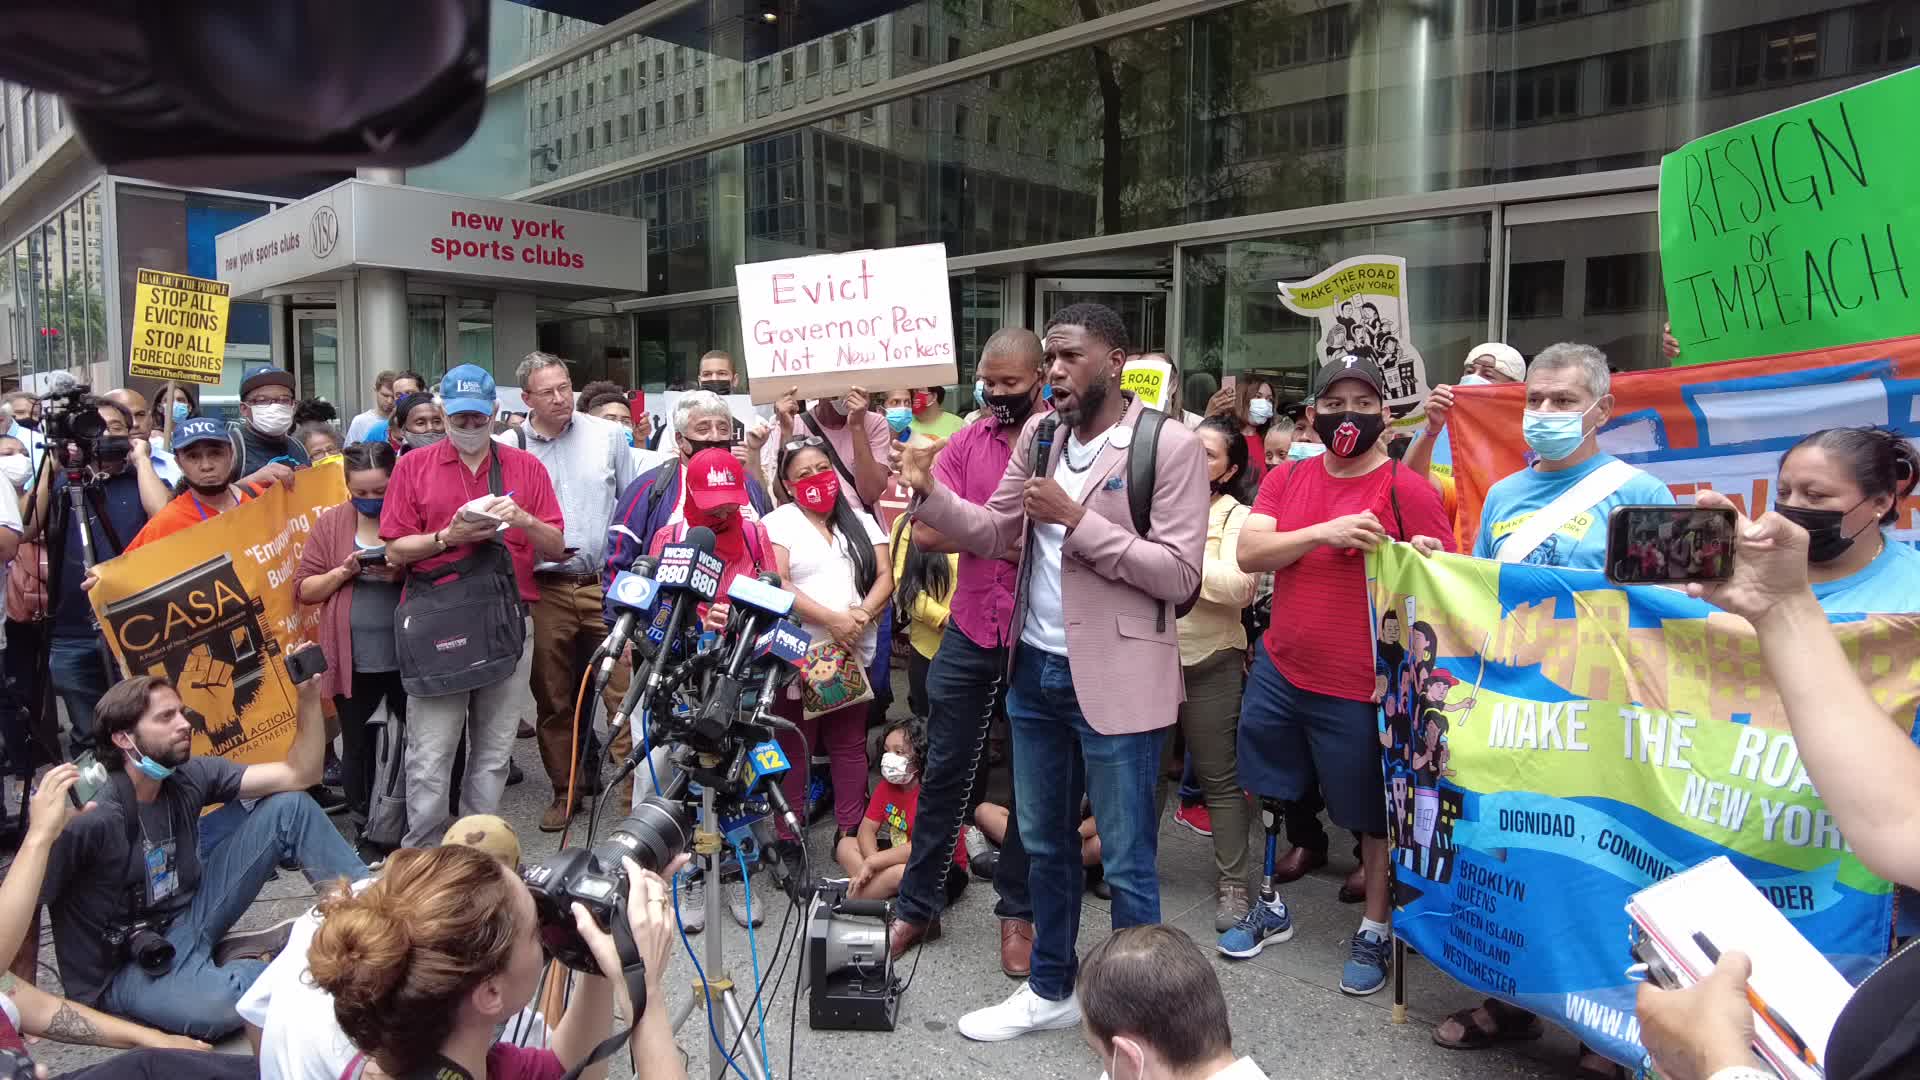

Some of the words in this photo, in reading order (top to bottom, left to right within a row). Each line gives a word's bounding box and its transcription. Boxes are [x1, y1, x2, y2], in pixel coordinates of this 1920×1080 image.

[1685, 102, 1868, 241] RESIGN
[312, 211, 334, 254] NYSC
[451, 210, 504, 232] new
[512, 219, 565, 241] york
[225, 258, 238, 272] new
[239, 251, 254, 272] york
[256, 239, 279, 265] sports
[279, 231, 300, 255] clubs
[431, 236, 514, 262] sports
[522, 243, 585, 269] clubs
[1750, 224, 1782, 263] or
[141, 271, 160, 285] BAIL
[162, 274, 180, 287] OUT
[182, 277, 196, 291] THE
[197, 279, 228, 295] PEOPLE
[772, 258, 875, 305] Evict
[1301, 284, 1333, 302] MAKE
[1332, 270, 1356, 289] THE
[1358, 268, 1396, 280] ROAD
[1343, 281, 1365, 295] NEW
[1368, 280, 1396, 292] YORK
[1673, 223, 1909, 346] IMPEACH
[151, 288, 189, 308] STOP
[190, 293, 215, 312] ALL
[145, 306, 218, 331] EVICTIONS
[754, 315, 882, 346] Governor
[891, 305, 937, 336] Perv
[145, 329, 184, 350] STOP
[186, 335, 213, 354] ALL
[772, 347, 815, 373] Not
[879, 337, 951, 363] Yorkers
[133, 348, 221, 371] FORECLOSURES
[1128, 374, 1160, 386] ROAD
[183, 422, 216, 437] NYC
[664, 547, 695, 559] WCBS
[698, 551, 723, 574] WCBS
[656, 564, 690, 584] 880
[690, 569, 718, 598] 880
[120, 580, 246, 651] CASA
[251, 709, 292, 736] ACTION
[756, 751, 784, 769] 12
[1488, 702, 1590, 752] MAKE
[1619, 707, 1697, 771] THE
[1730, 725, 1820, 798] ROA
[1680, 773, 1752, 833] NEW
[1759, 797, 1853, 853] YOR
[1457, 882, 1496, 914] QUEENS
[1486, 919, 1525, 948] ISLAND
[1474, 937, 1511, 966] ISLAND
[1442, 941, 1517, 997] WESTCHESTER
[1565, 992, 1642, 1047] WWW.M
